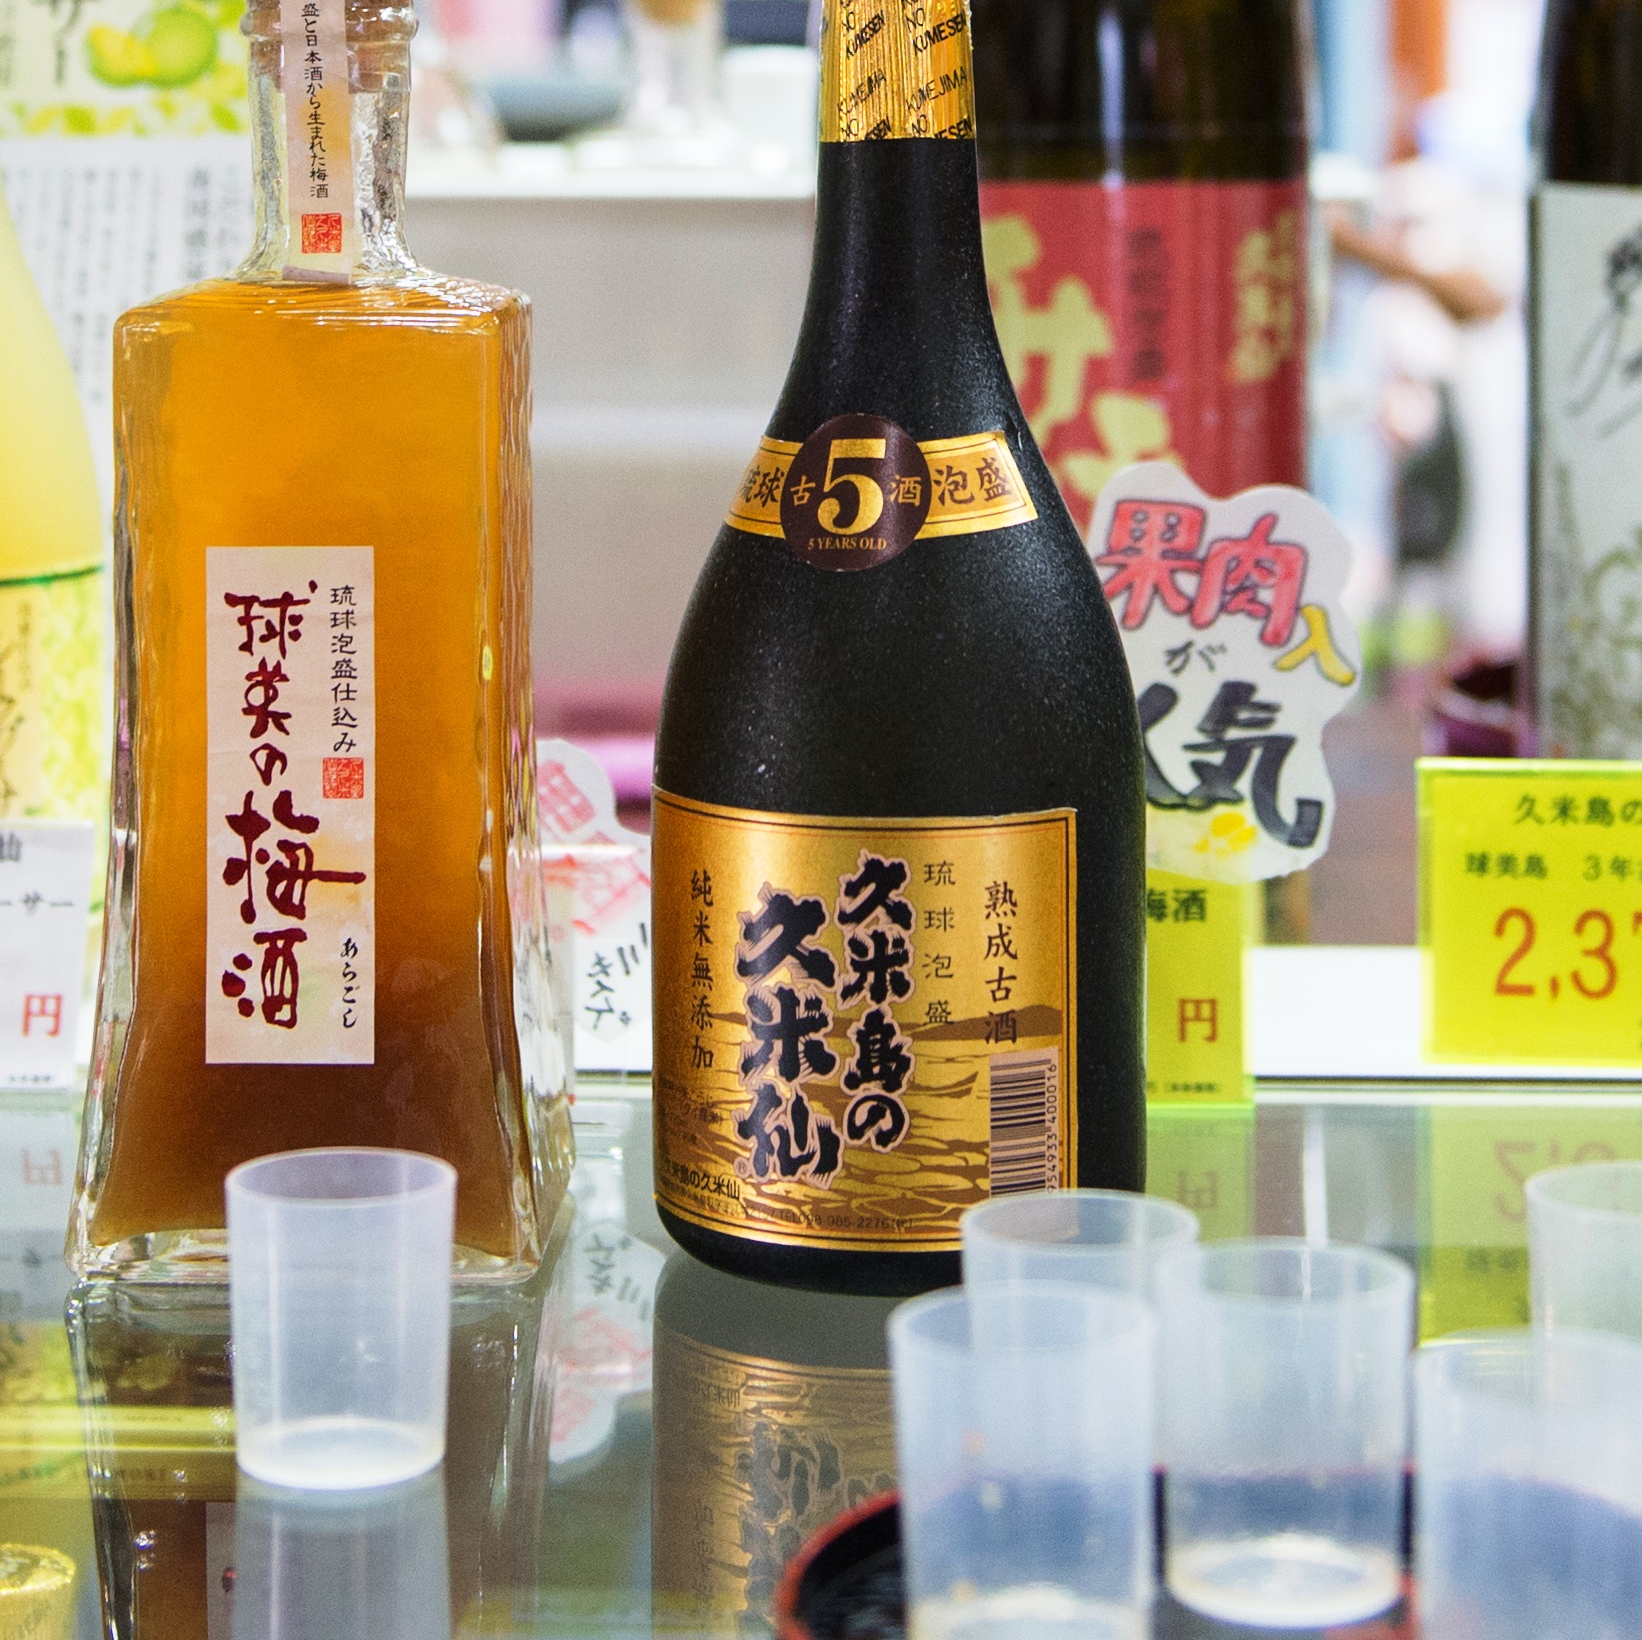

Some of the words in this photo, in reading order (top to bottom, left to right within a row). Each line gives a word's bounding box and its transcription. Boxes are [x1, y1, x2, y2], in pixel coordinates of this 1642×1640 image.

[912, 12, 968, 56] KUMESEN
[905, 65, 968, 114] KUMEJIMA
[789, 475, 816, 508] 古
[817, 438, 887, 536] 5
[889, 473, 922, 508] 酒
[933, 456, 1012, 507] 泡盛
[808, 536, 815, 550] 5
[818, 537, 857, 551] YEARS
[859, 537, 888, 551] OLD
[330, 584, 358, 753] 琉球泡盛仕込み
[1165, 639, 1227, 676] が
[221, 579, 366, 1029] 球美の梅酒
[1464, 851, 1549, 881] 球美島
[340, 937, 359, 1030] あらごし
[689, 869, 715, 1071] 純米無添加
[922, 860, 956, 1028] 琉球泡盛
[983, 879, 1019, 1046] 熟成古酒
[21, 992, 63, 1038] 円
[735, 882, 843, 1189] 久米仙
[837, 848, 914, 1154] 久米島の
[1178, 998, 1219, 1043] 円
